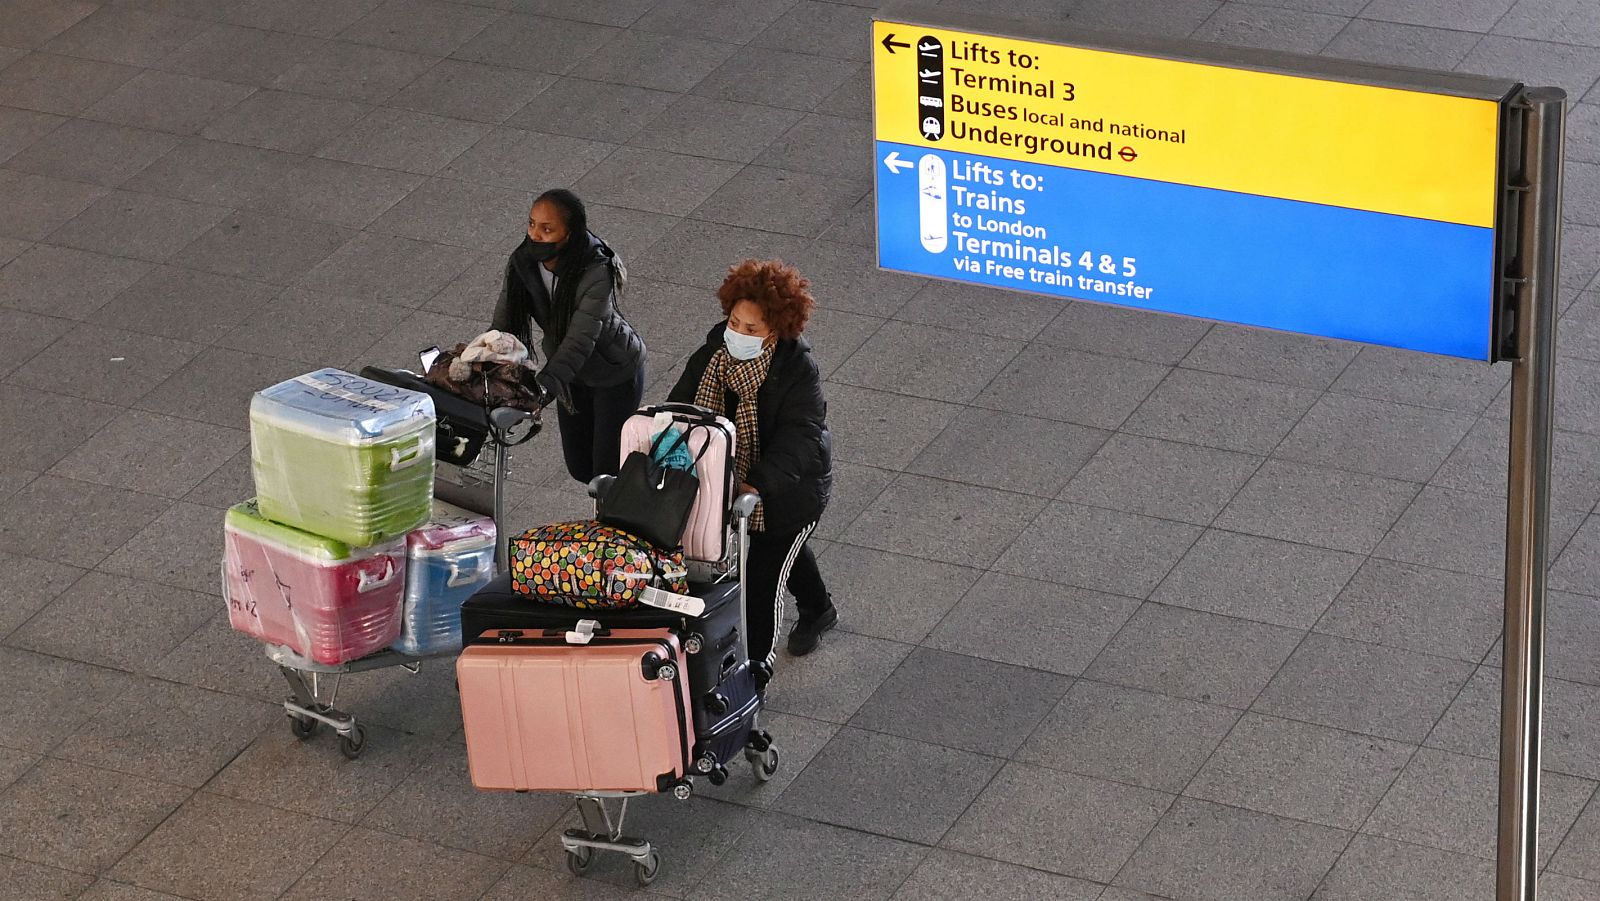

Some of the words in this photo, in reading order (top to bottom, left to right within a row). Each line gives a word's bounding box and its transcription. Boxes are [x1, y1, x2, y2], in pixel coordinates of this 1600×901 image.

[951, 41, 1001, 65] Lifts
[1007, 50, 1039, 70] to:
[951, 67, 1054, 99] Terminal
[1062, 83, 1075, 102] 3
[951, 94, 1018, 121] Buses
[1023, 107, 1064, 127] local
[1069, 117, 1103, 133] and
[1110, 123, 1185, 144] national
[951, 120, 1112, 161] Underground
[952, 159, 1004, 186] Lifts
[1009, 169, 1044, 192] to:
[952, 185, 1026, 215] Trains
[952, 212, 973, 229] to
[977, 214, 1047, 240] London
[952, 231, 1072, 268] Terminals
[1078, 251, 1094, 271] 4
[1098, 254, 1117, 275] &
[1122, 257, 1137, 278] 5
[953, 256, 981, 273] via
[985, 259, 1025, 280] Free
[1028, 267, 1073, 288] train
[1077, 274, 1153, 300] transfer
